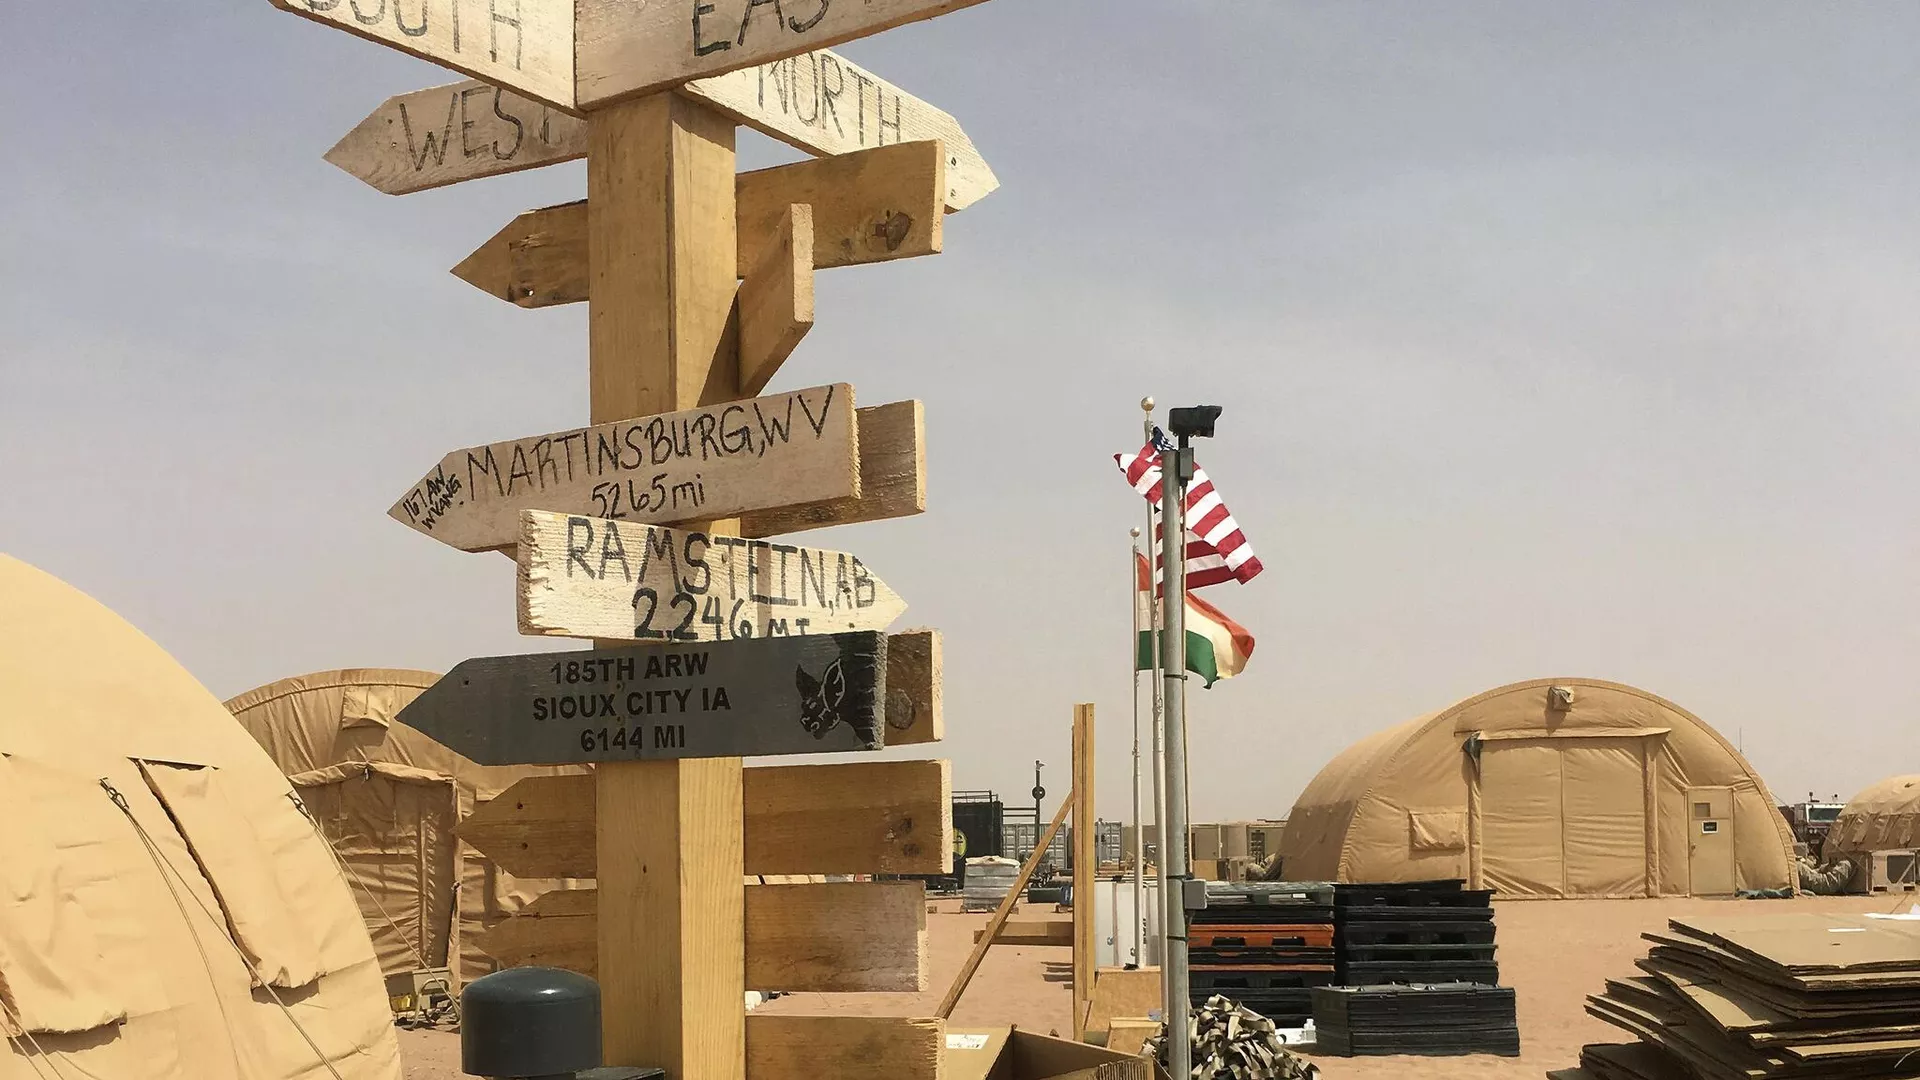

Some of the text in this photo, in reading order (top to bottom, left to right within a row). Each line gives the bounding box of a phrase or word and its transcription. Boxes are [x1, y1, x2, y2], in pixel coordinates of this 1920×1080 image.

[757, 51, 901, 147] NORTH
[550, 652, 709, 685] 185TH ARW
[532, 686, 732, 721] SIOUX CITY IA
[580, 724, 686, 752] 6144 MI
